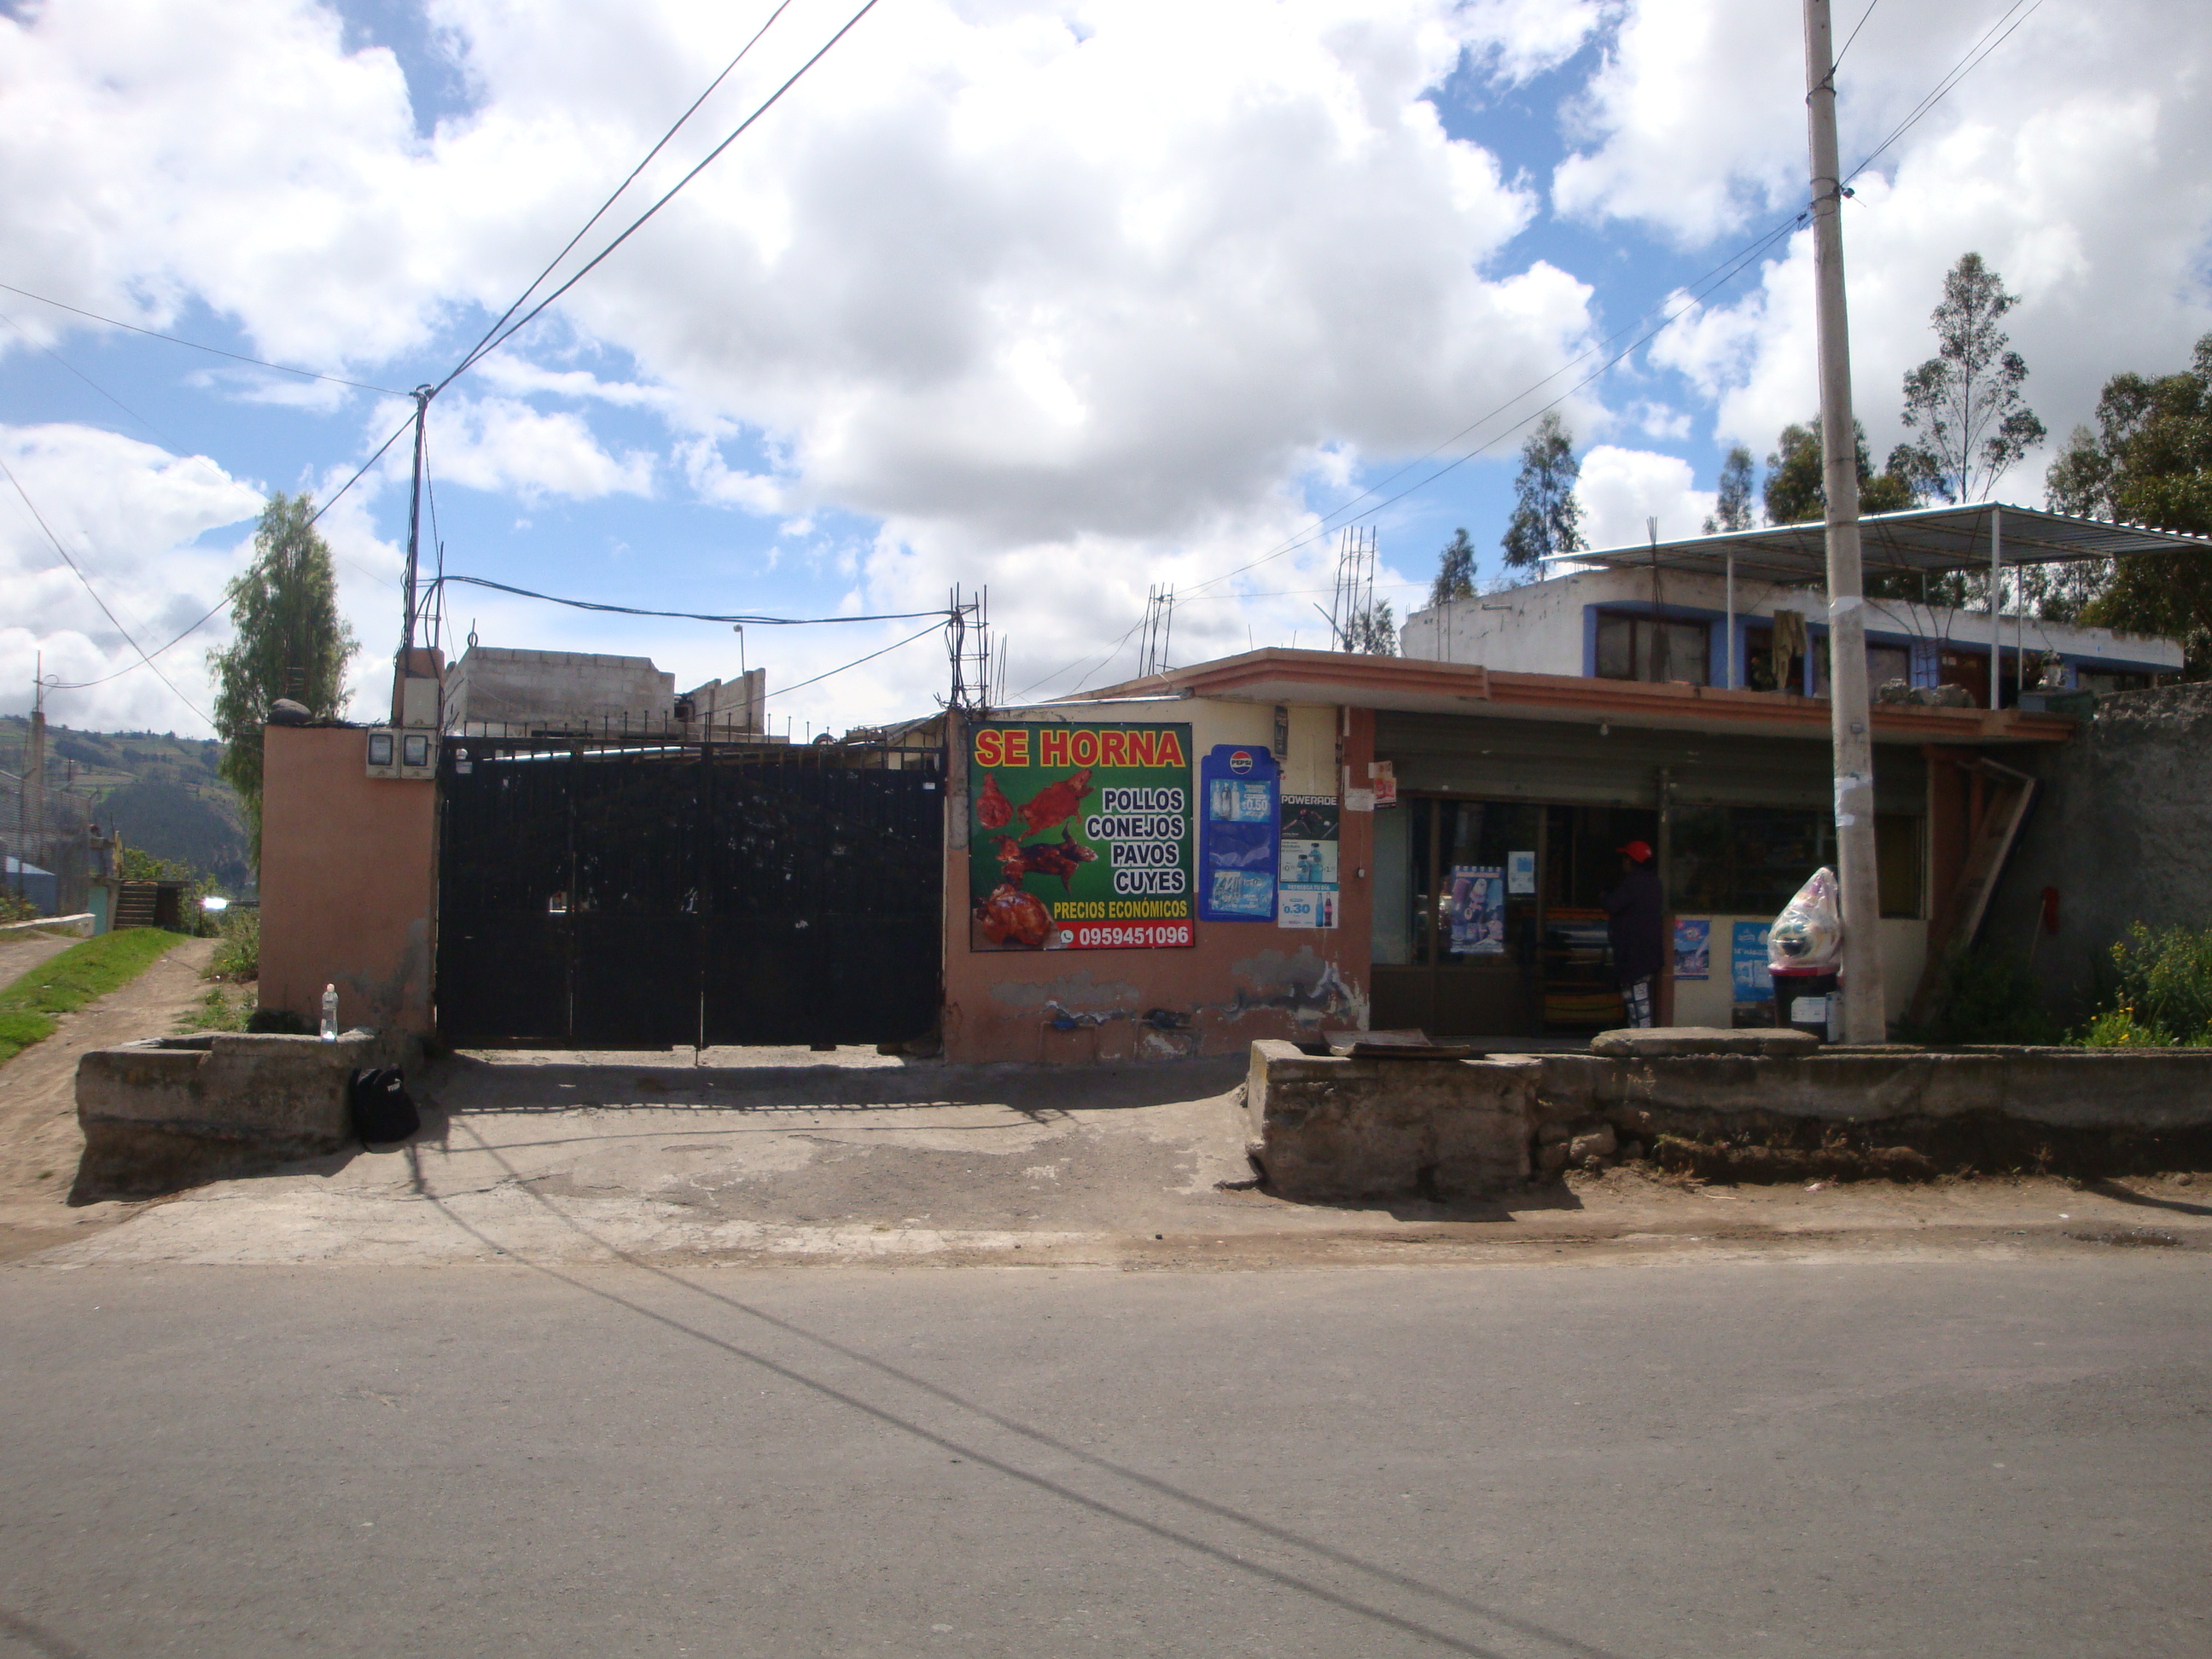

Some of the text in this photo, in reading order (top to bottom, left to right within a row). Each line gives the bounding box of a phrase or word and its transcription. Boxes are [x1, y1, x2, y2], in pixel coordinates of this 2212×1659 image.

[975, 729, 1186, 767] SE HORNA
[1103, 788, 1185, 812] POLLOS
[1281, 795, 1337, 806] POWERADE
[1086, 814, 1185, 840] CONEJOS
[1111, 841, 1179, 867] PAVOS
[1114, 869, 1185, 894] CUYES
[1053, 897, 1189, 919] PRECIOS ECONÓMICOS
[1080, 926, 1189, 946] 0959451096
